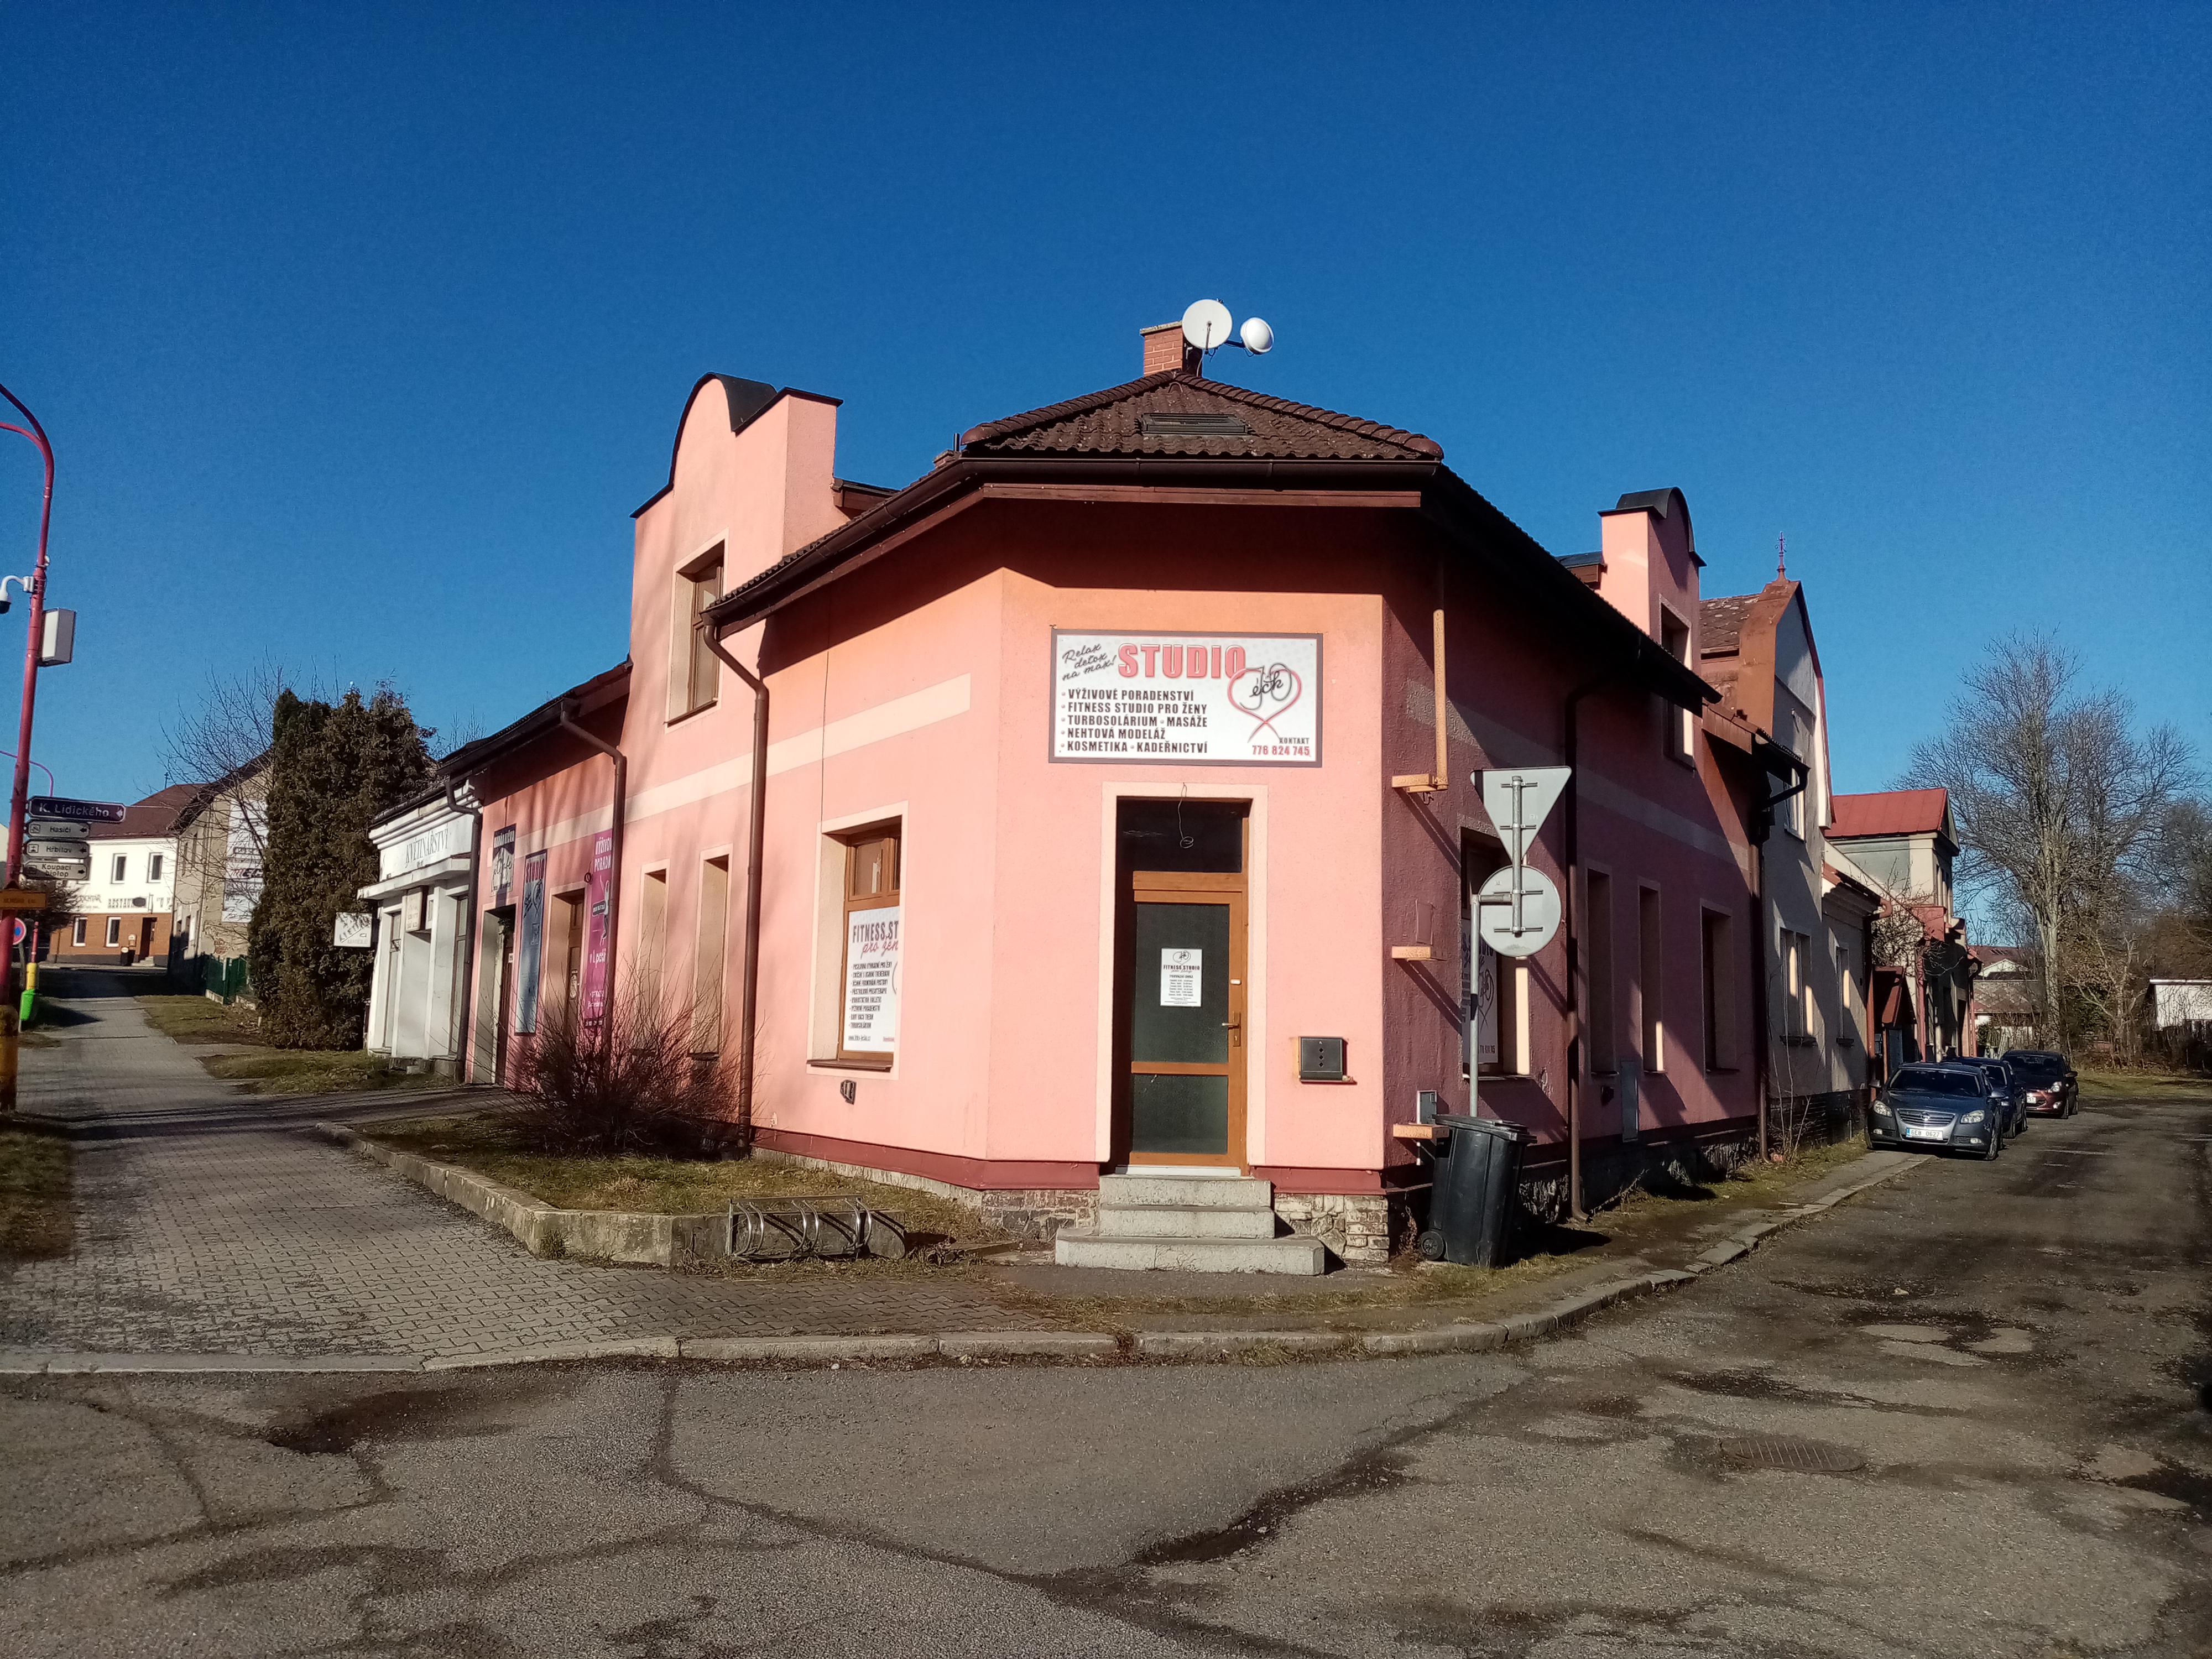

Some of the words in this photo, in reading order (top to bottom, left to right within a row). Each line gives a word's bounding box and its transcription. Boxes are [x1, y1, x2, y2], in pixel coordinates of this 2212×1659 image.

[1062, 644, 1102, 664] Relax
[1074, 653, 1108, 669] detox
[1062, 671, 1081, 681] na
[1084, 654, 1117, 674] max!
[1117, 643, 1246, 680] STUDIO
[1068, 688, 1118, 700] VÝŽIVOVÉ
[1121, 690, 1194, 701] PORADENSTVÍ
[1068, 702, 1111, 712] FITNESS
[1115, 703, 1154, 713] STUDIO
[1158, 703, 1178, 713] PRO
[1182, 702, 1207, 714] ŽENY
[1068, 714, 1157, 726] TURBOSOLÁRIUM
[1167, 715, 1207, 727] MASÁŽE
[1067, 727, 1114, 739] NEHTOVÁ
[1118, 727, 1166, 739] MODELÁŽ
[1067, 740, 1128, 752] KOSMETIKA
[1137, 740, 1208, 753] KADEŘNICTVÍ
[1252, 745, 1269, 755] 776
[1272, 745, 1290, 755] 824
[1293, 747, 1310, 756] 745
[55, 805, 109, 817] Lidického
[526, 858, 545, 883] STUDIO
[853, 922, 885, 943] FITNESS
[860, 942, 879, 959] pro
